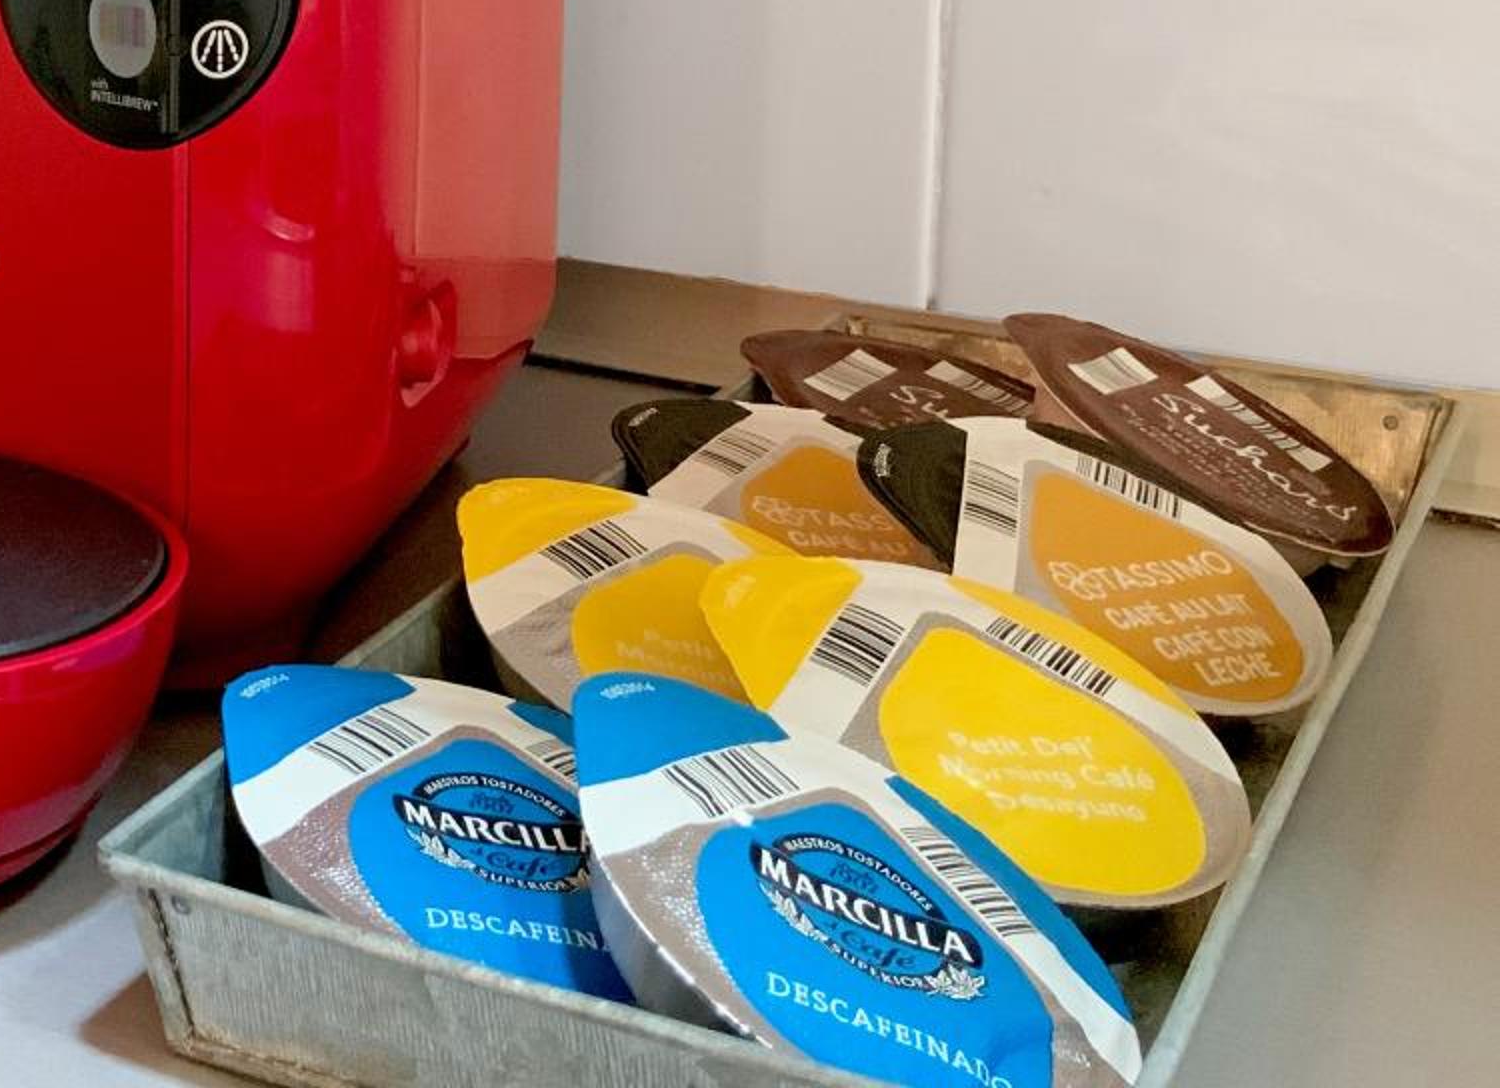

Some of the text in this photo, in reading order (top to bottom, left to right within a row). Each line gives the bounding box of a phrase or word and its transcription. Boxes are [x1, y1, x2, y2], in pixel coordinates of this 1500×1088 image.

[801, 509, 896, 531] TASS
[1101, 550, 1234, 592] TASSIMO
[1169, 597, 1210, 623] AU
[1192, 652, 1283, 686] LECHE
[479, 776, 566, 818] TOSTADORES
[845, 847, 933, 911] TOSTADORES
[760, 848, 975, 964] MARCILLA
[424, 907, 613, 953] DESCAFEIN
